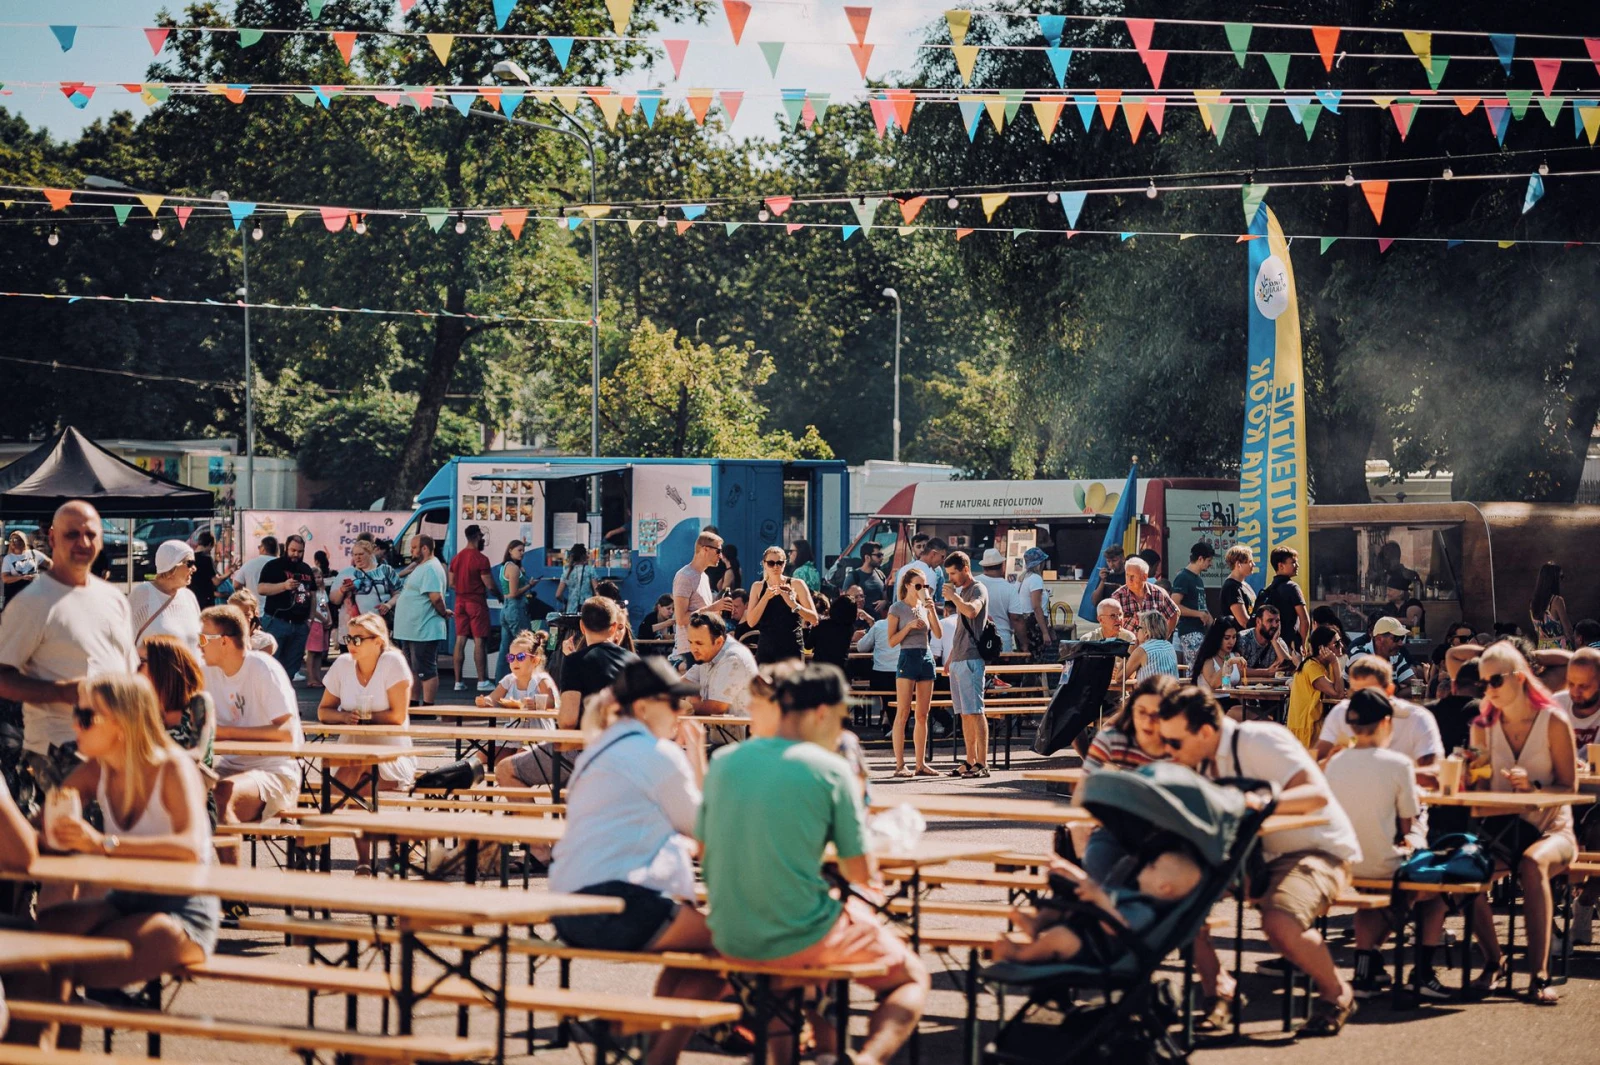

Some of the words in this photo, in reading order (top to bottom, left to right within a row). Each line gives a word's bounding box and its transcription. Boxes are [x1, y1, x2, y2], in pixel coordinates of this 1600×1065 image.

[940, 499, 954, 508] THE
[956, 498, 991, 508] NATURAL
[993, 497, 1044, 507] REVOLUTION
[345, 522, 385, 533] Tallinn
